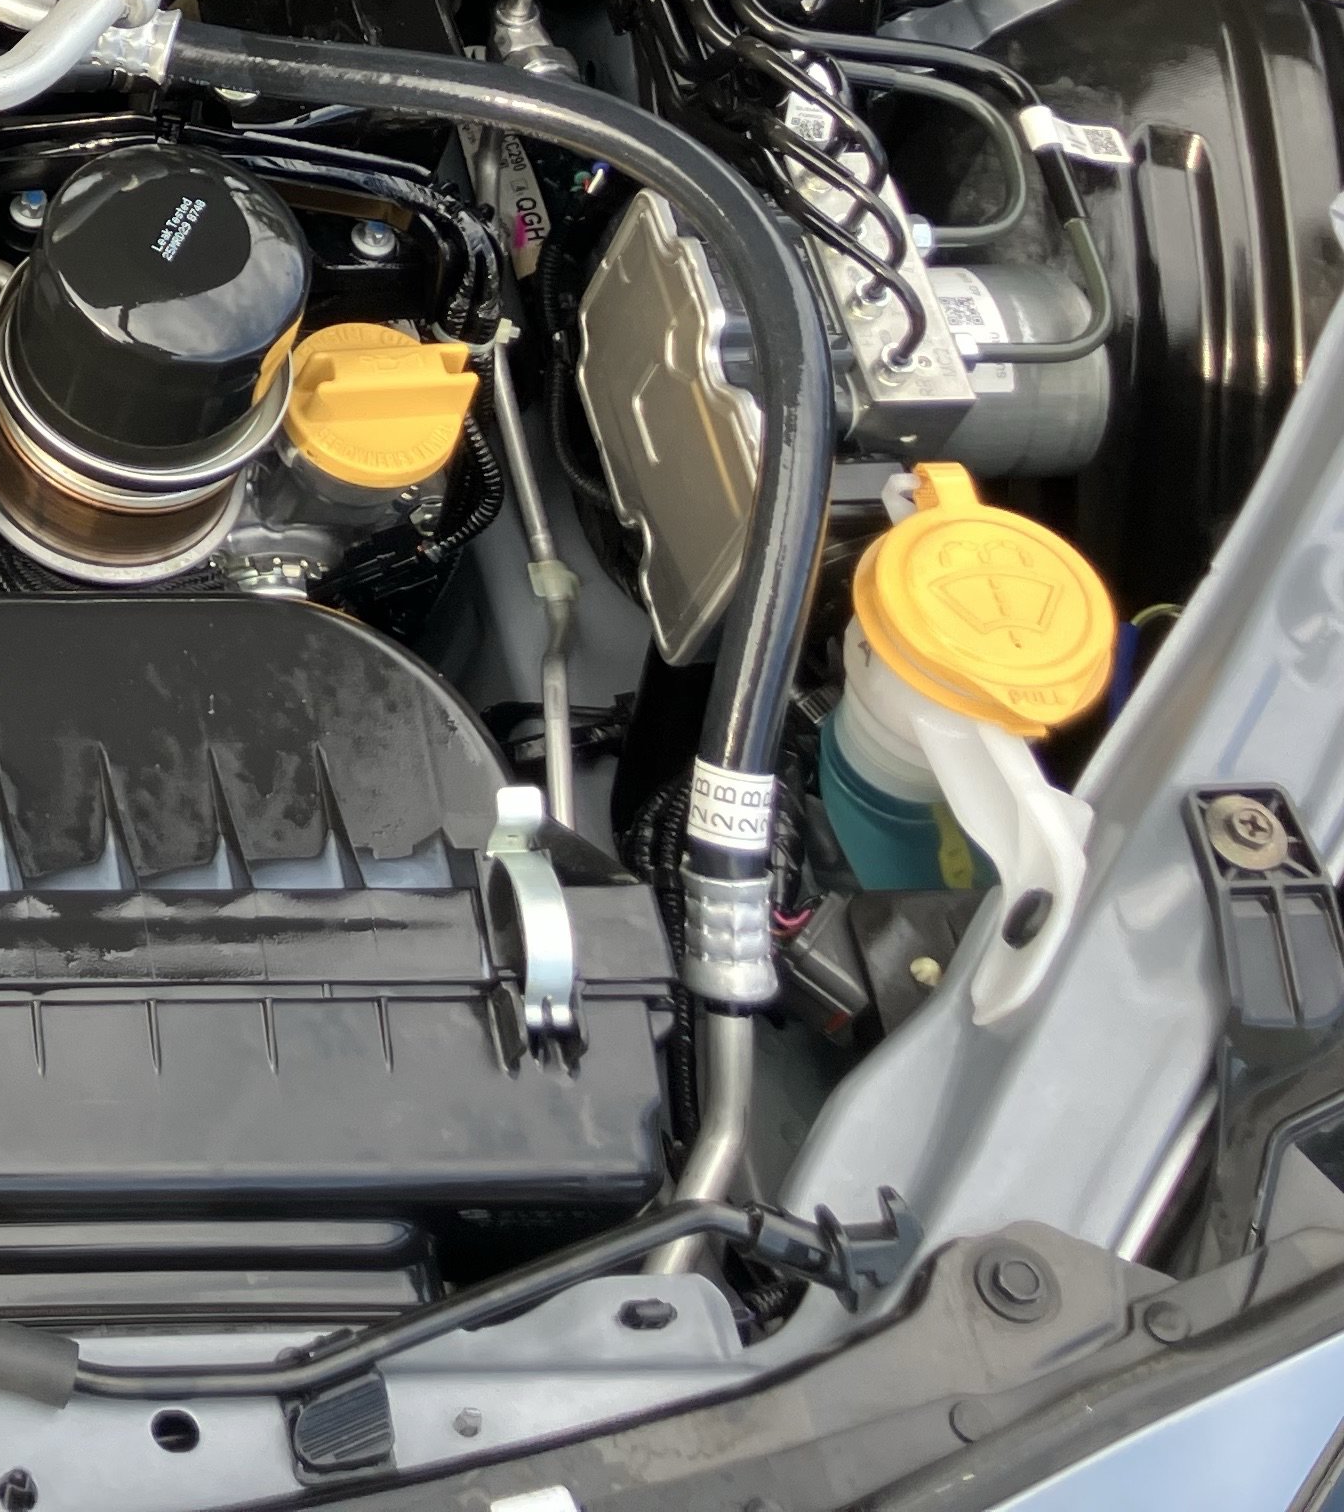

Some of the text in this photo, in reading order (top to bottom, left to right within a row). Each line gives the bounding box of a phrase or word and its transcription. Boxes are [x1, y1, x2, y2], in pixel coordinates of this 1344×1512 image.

[150, 196, 193, 252] Leak Tested
[516, 197, 547, 243] QGH
